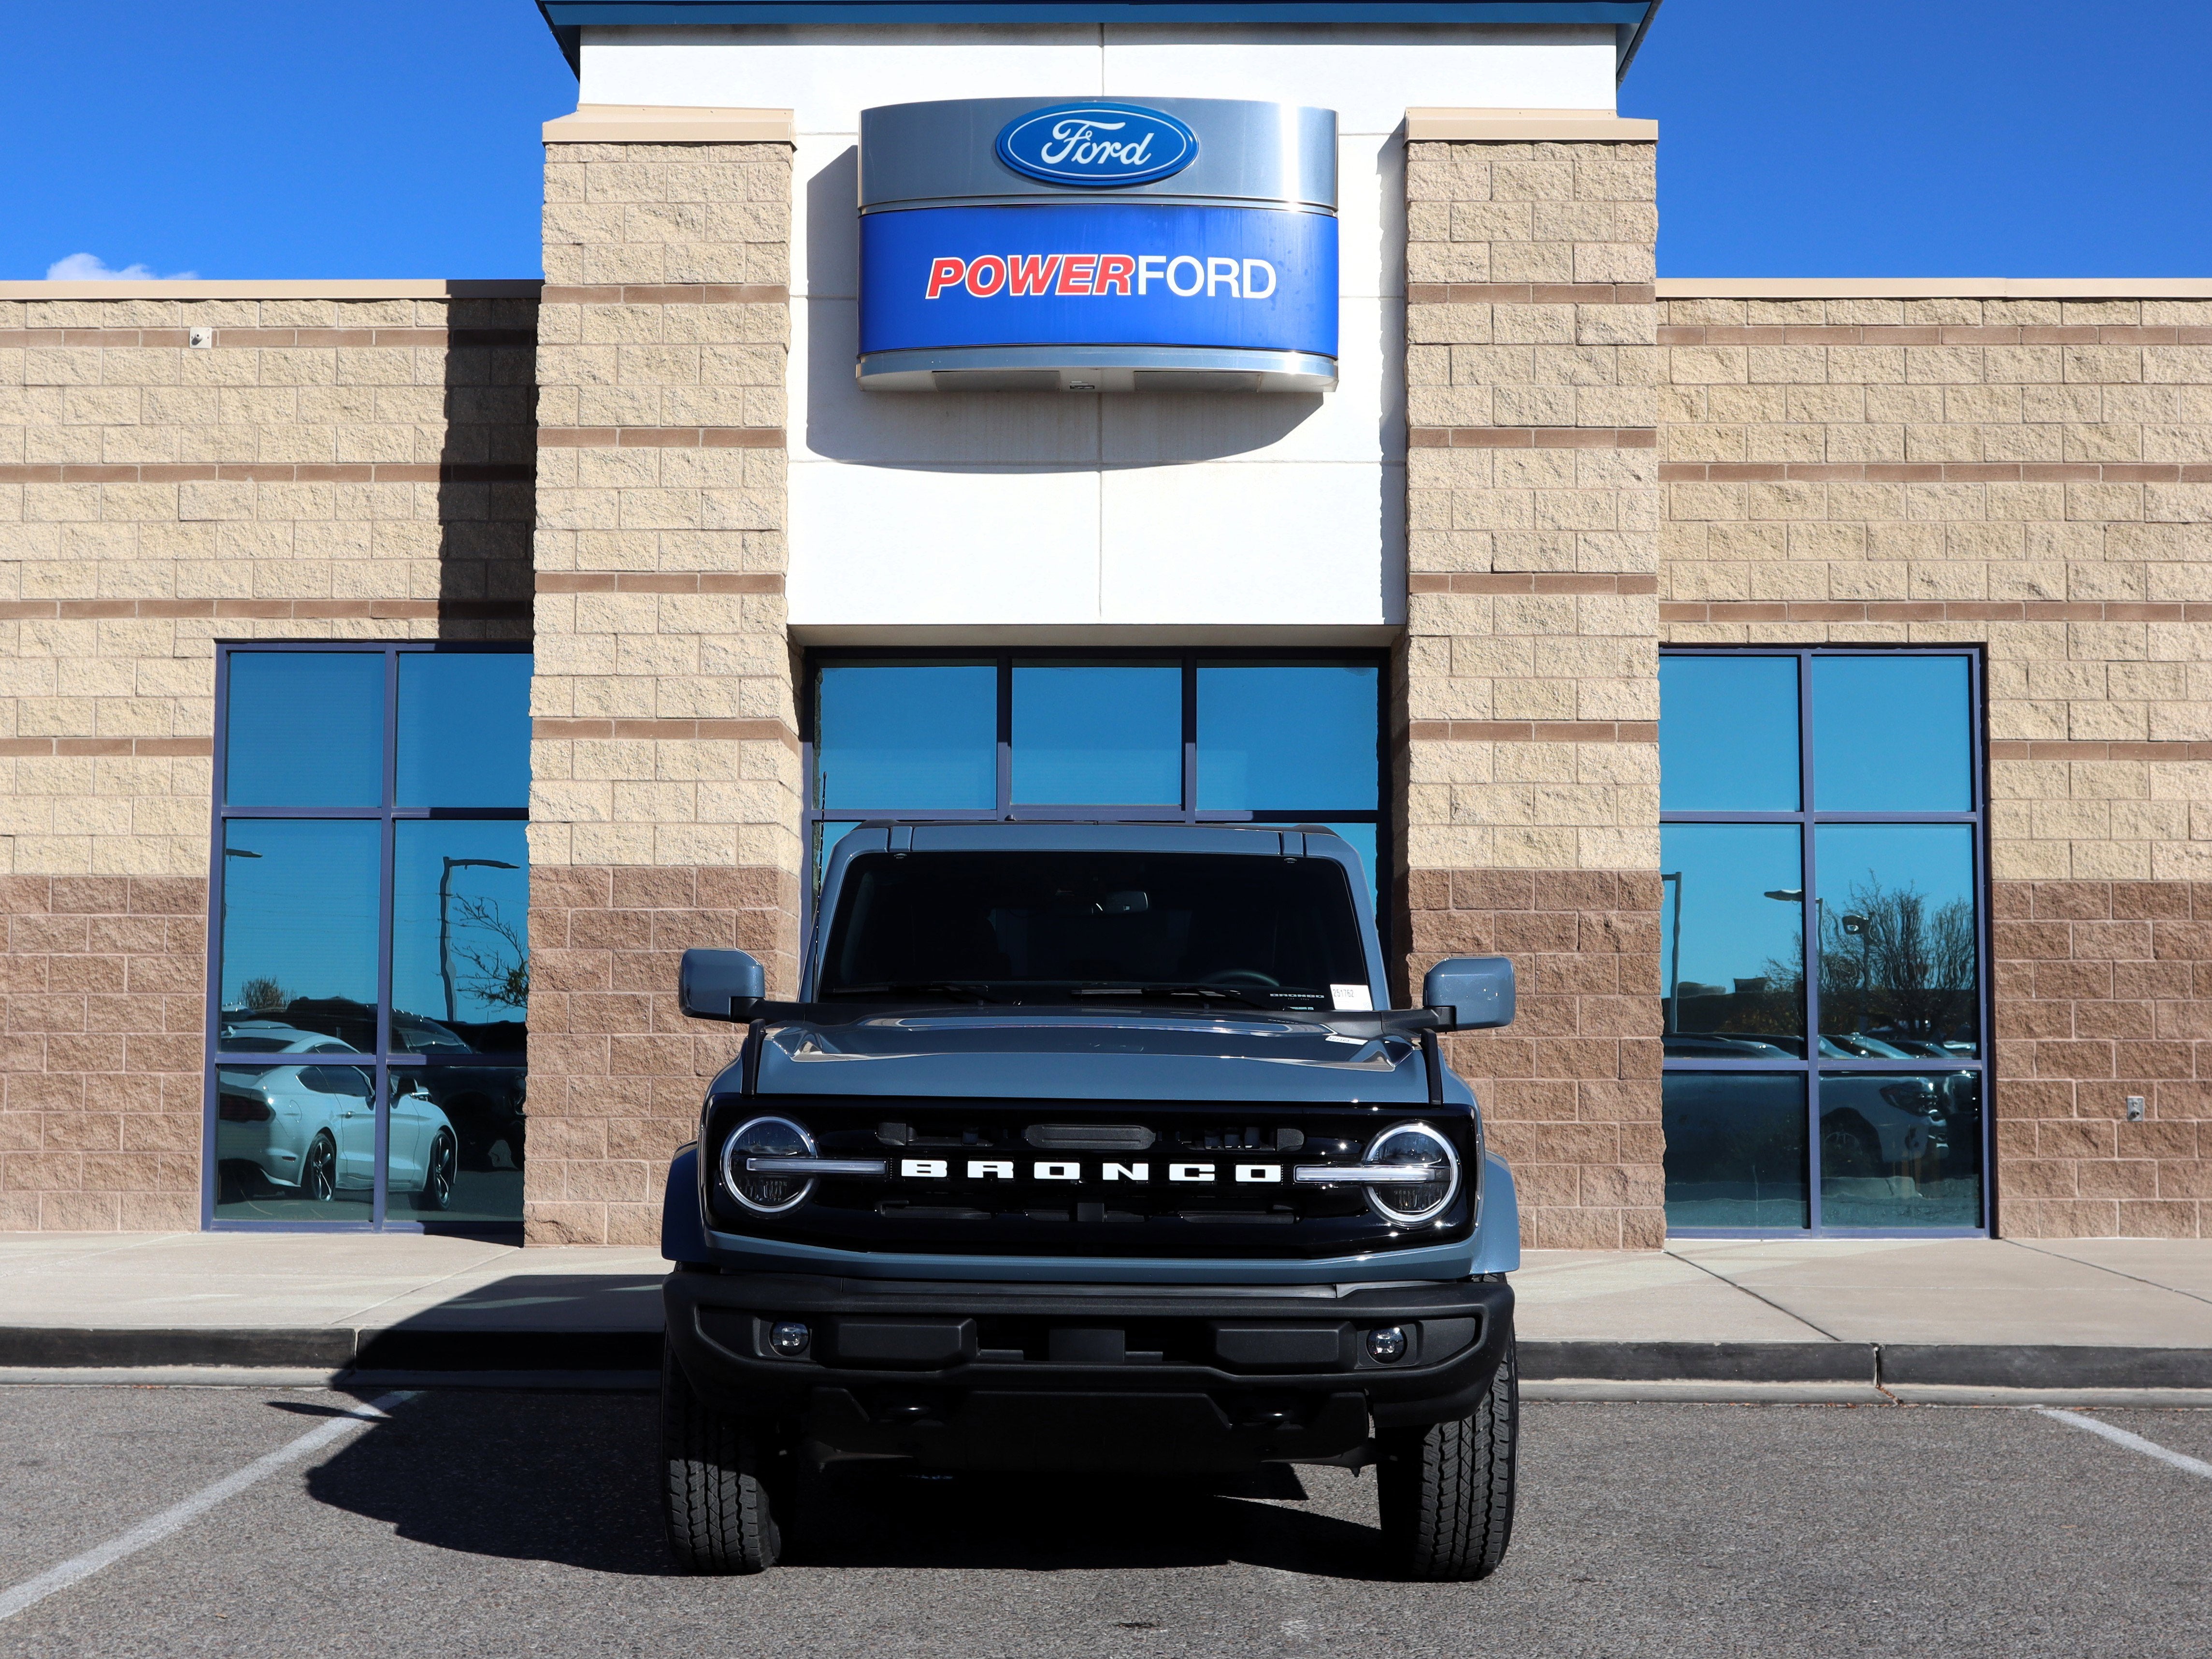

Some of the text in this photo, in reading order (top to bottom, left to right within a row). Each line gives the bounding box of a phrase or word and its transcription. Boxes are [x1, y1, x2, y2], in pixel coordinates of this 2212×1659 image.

[1041, 119, 1154, 165] Ford
[1333, 989, 1354, 997] 251762
[901, 1159, 1281, 1182] BRONCO
